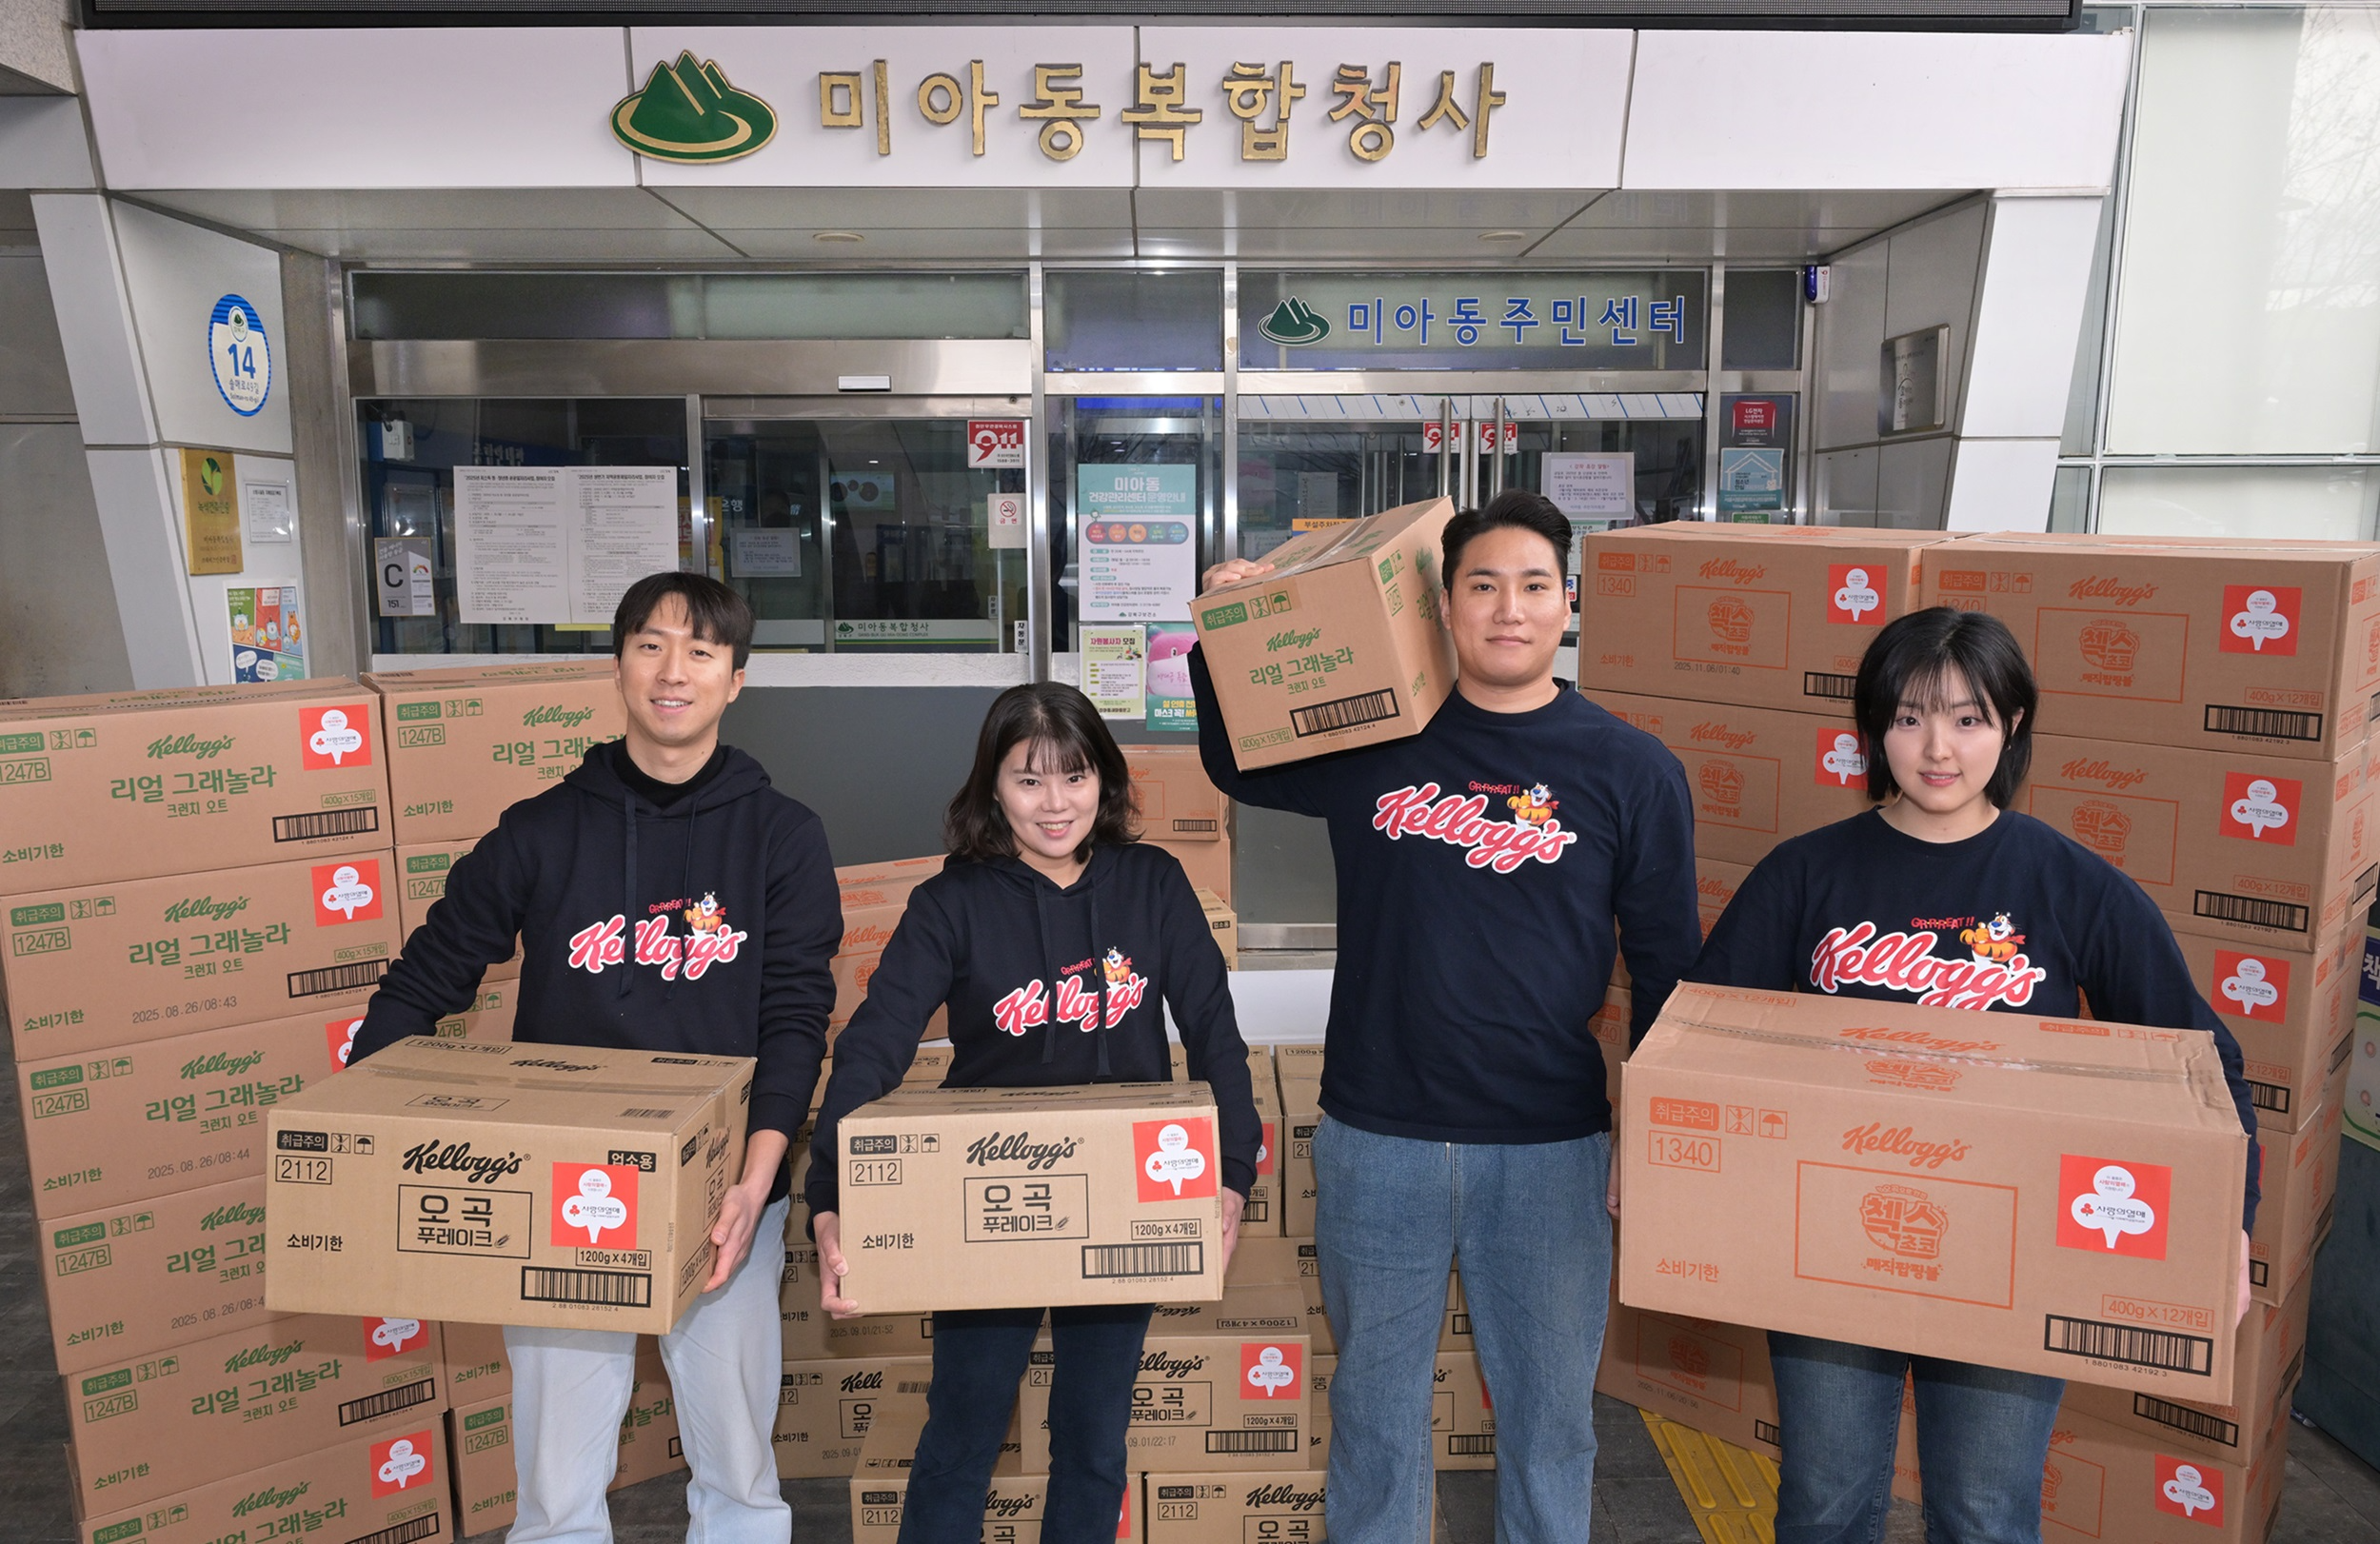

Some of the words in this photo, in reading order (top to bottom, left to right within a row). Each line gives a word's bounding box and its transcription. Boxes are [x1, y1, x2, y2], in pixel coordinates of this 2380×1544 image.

[817, 58, 1508, 163] 미아동복합청사
[1348, 295, 1685, 346] 미아동주민센터
[228, 344, 256, 379] 14
[1114, 477, 1160, 492] 미아동
[1089, 492, 1146, 503] 건강관리센터
[1147, 492, 1186, 503] 운영안내
[384, 564, 404, 588] C
[1699, 558, 1768, 584] Kellogg's
[1942, 573, 1983, 589] 취급주의
[1601, 577, 1632, 594] 1340
[2068, 575, 2159, 605] Kellogg's
[387, 600, 400, 608] 151
[858, 623, 929, 632] 미아동복합청사
[1205, 606, 1244, 626] 취급주의
[1266, 627, 1321, 652] Kellogg's
[1249, 664, 1284, 686] 리얼
[1286, 646, 1354, 678] 그래놀라
[1599, 654, 1635, 667] 소비기한
[1287, 680, 1309, 695] 크런치
[1312, 677, 1327, 690] 오트
[401, 704, 439, 718] 취급주의
[523, 705, 594, 728] Kellogg's
[147, 733, 233, 761] Kellogg's
[401, 728, 442, 744] 1247B
[1691, 722, 1757, 749] Kellogg's
[492, 741, 535, 766] 리얼
[537, 764, 564, 780] 크런치
[2061, 758, 2148, 789] Kellogg's
[110, 775, 164, 803] 리얼
[172, 765, 277, 796] 그래놀라
[167, 801, 200, 819] 크런치
[207, 799, 228, 814] 오트
[404, 800, 453, 817] 소비기한
[1372, 782, 1569, 874] Kellogg's
[2, 842, 65, 863] 소비기한
[410, 856, 447, 870] 취급주의
[15, 906, 63, 922] 취급주의
[164, 896, 248, 922] Kellogg's
[16, 931, 68, 953] 1247B
[129, 937, 181, 966] 리얼
[188, 922, 291, 957] 그래놀라
[184, 962, 217, 980] 크런치
[223, 959, 244, 974] 오트
[1810, 920, 2037, 1011] Kellogg's
[24, 1010, 85, 1032] 소비기한
[132, 997, 237, 1024] 2025.08.26/08:43
[1838, 1026, 2008, 1053] Kellogg's
[181, 1050, 265, 1079] Kellogg's
[35, 1068, 81, 1086] 취급주의
[35, 1094, 86, 1116] 1247B
[146, 1094, 197, 1122] 리얼
[205, 1074, 305, 1112] 그래놀라
[200, 1116, 231, 1134] 크런치
[237, 1111, 258, 1127] 오트
[1655, 1102, 1716, 1127] 취급주의
[281, 1133, 326, 1150] 취급주의
[852, 1137, 896, 1152] 취급주의
[966, 1131, 1079, 1170] Kellogg's
[1654, 1138, 1716, 1167] 1340
[1842, 1121, 1969, 1169] Kellogg's
[148, 1149, 249, 1179] 2025.08.26/08:44
[280, 1158, 327, 1181] 2112
[402, 1138, 524, 1184] Kellogg's
[43, 1168, 103, 1191] 소비기한
[853, 1162, 898, 1184] 2112
[1864, 1197, 1939, 1237] 첵스
[2096, 1205, 2146, 1218] 사랑의열매
[58, 1225, 103, 1244] 취급주의
[982, 1215, 1054, 1235] 푸레이크
[287, 1233, 343, 1253] 소비기한
[417, 1227, 493, 1248] 푸레이크
[862, 1234, 915, 1251] 소비기한
[1899, 1235, 1935, 1254] 초코
[60, 1249, 108, 1273] 1247B
[167, 1245, 216, 1274] 리얼
[1655, 1257, 1720, 1283] 소비기한
[219, 1265, 250, 1284] 크런치
[66, 1320, 125, 1346] 소비기한
[224, 1339, 305, 1374] Kellogg's
[86, 1370, 130, 1393] 취급주의
[454, 1361, 501, 1383] 소비기한
[191, 1387, 239, 1417] 리얼
[248, 1358, 342, 1400] 그래놀라
[88, 1395, 134, 1419] 1247B
[242, 1405, 274, 1424] 크런치
[278, 1397, 298, 1415] 오트
[467, 1409, 503, 1428] 취급주의
[1131, 1409, 1185, 1421] 푸레이크
[467, 1430, 506, 1452] 1247B
[774, 1432, 809, 1443] 소비기한
[93, 1462, 150, 1491] 소비기한
[232, 1480, 311, 1517] Kellogg's
[470, 1490, 516, 1514] 소비기한
[864, 1493, 896, 1502] 취급주의
[1160, 1487, 1193, 1498] 취급주의
[254, 1498, 348, 1543] 그래놀라
[866, 1511, 899, 1523] 2112
[1160, 1504, 1195, 1518] 2112
[96, 1519, 141, 1544] 취급주의
